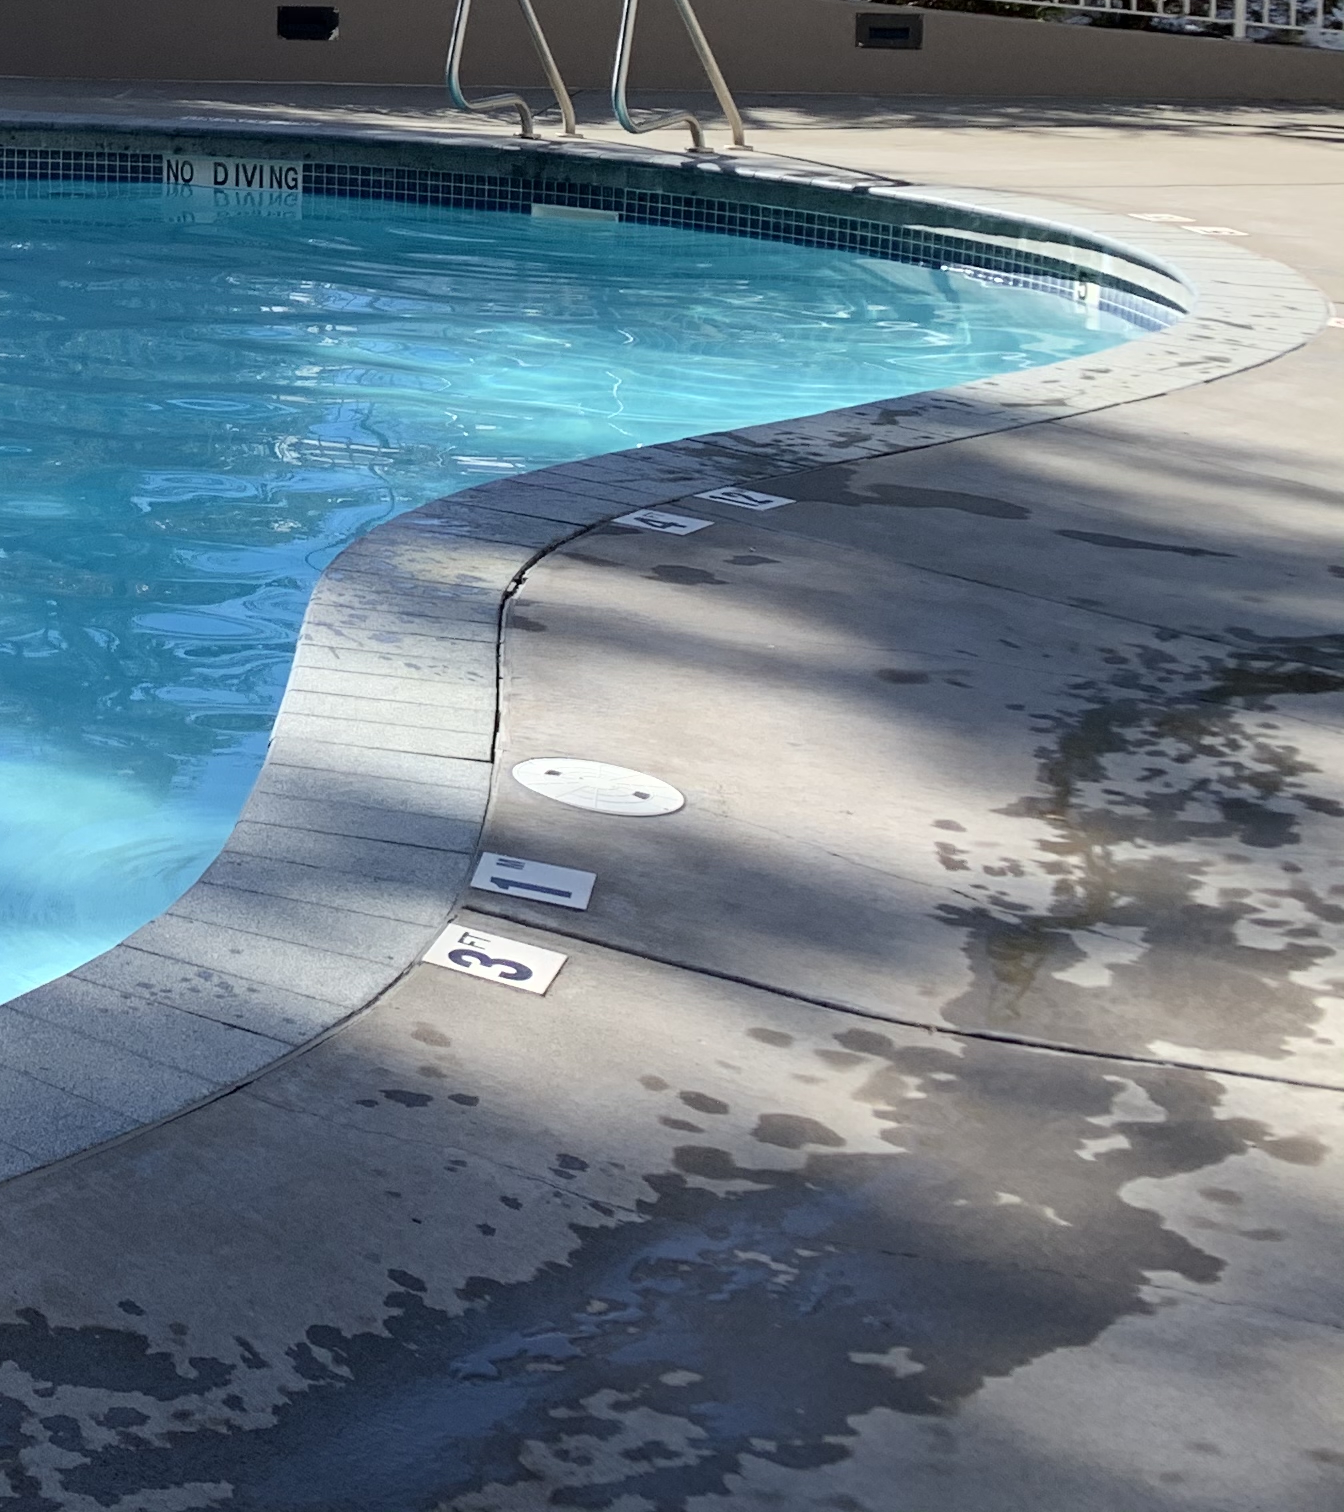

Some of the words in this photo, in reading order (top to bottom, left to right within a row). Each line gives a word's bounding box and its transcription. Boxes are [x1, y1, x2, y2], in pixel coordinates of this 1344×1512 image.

[166, 159, 194, 185] NO
[213, 161, 299, 190] DIVING
[633, 516, 687, 529] 4
[490, 875, 573, 899] 1
[457, 931, 492, 950] FT
[448, 948, 533, 981] 3
